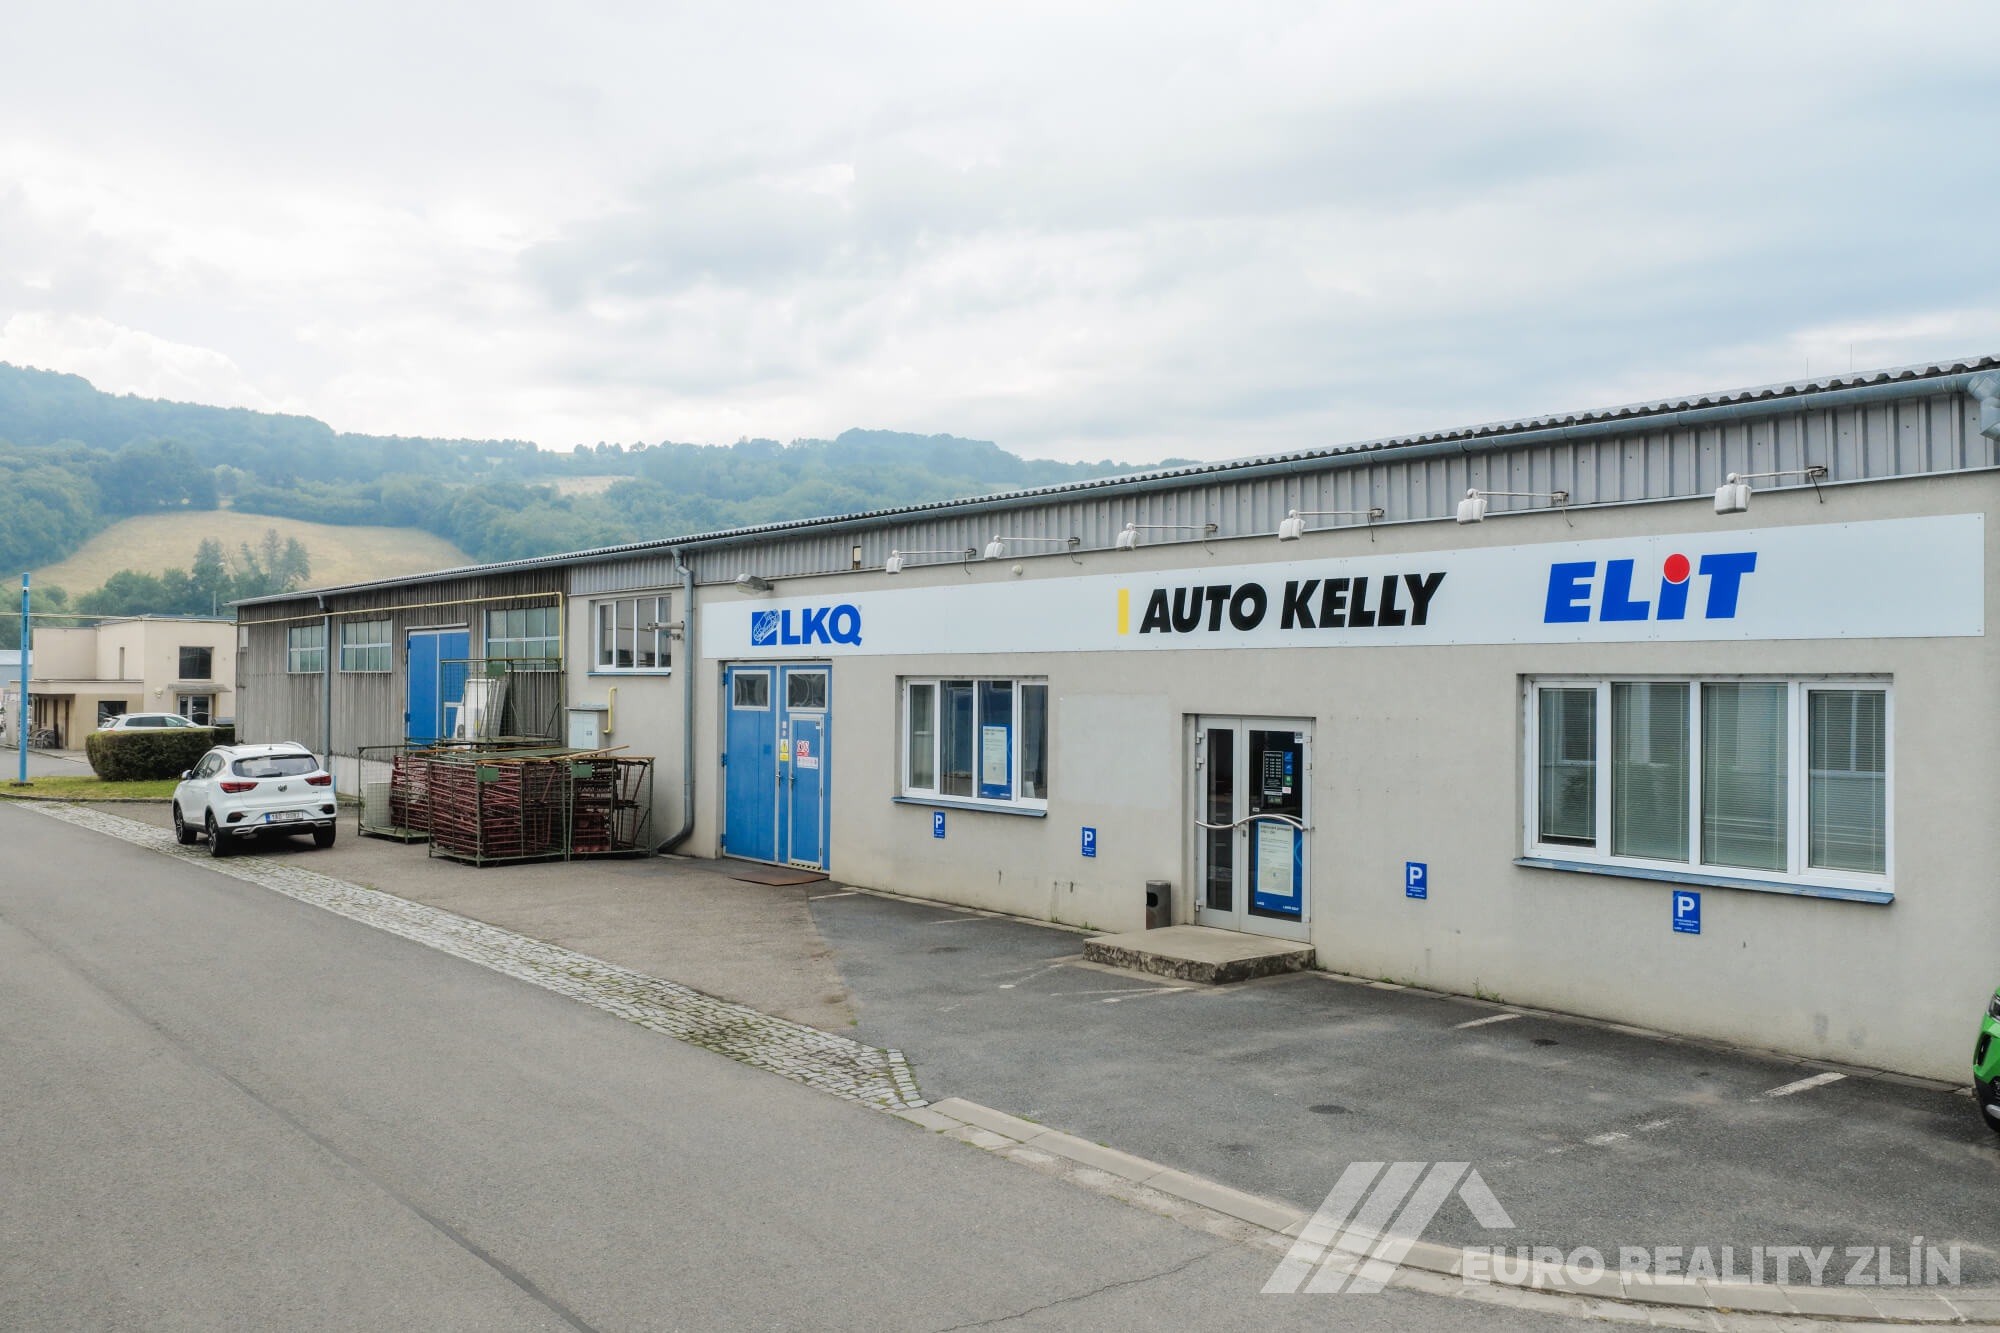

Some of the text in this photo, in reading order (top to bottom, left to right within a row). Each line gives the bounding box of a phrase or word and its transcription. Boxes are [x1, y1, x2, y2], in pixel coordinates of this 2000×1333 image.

[1139, 572, 1446, 633] AUTO KELLY
[781, 604, 862, 646] LKQ
[935, 814, 943, 828] P
[1084, 831, 1093, 846] P
[1410, 866, 1423, 884] P
[1678, 896, 1695, 917] P
